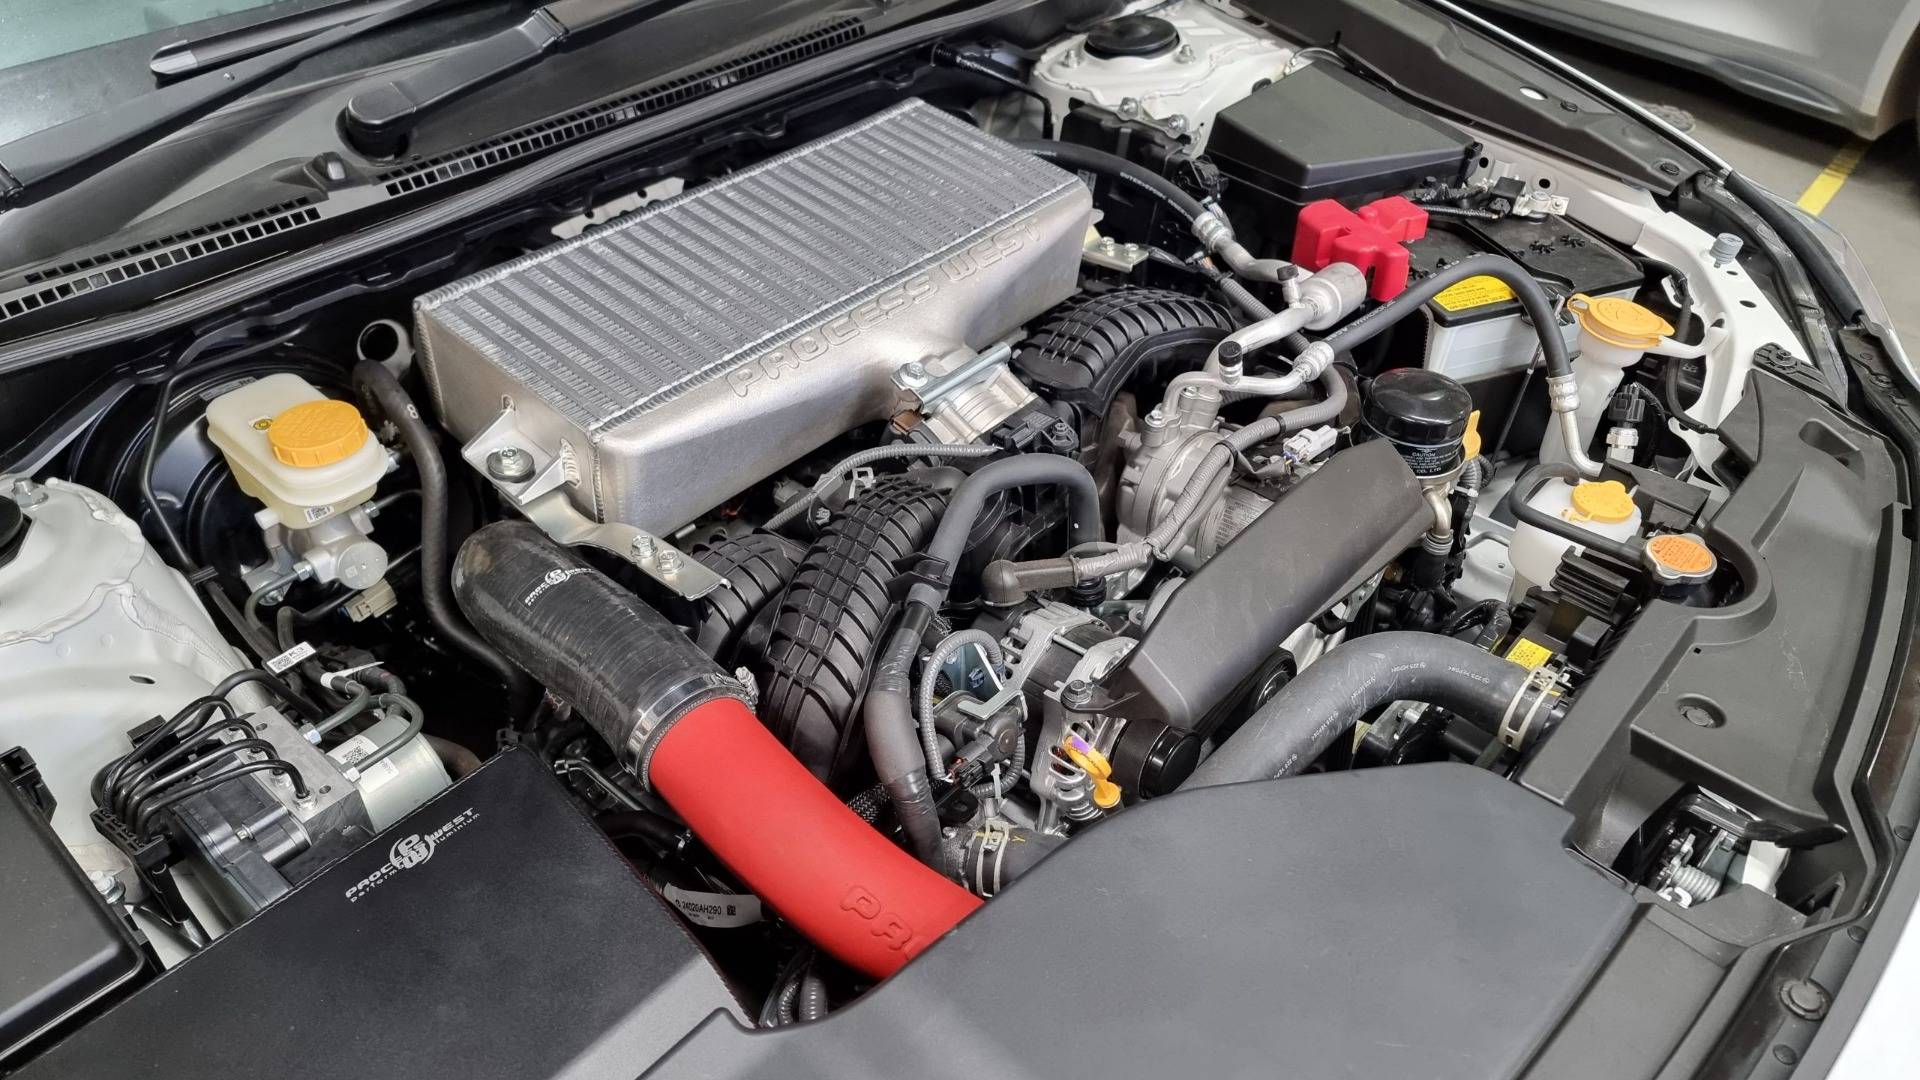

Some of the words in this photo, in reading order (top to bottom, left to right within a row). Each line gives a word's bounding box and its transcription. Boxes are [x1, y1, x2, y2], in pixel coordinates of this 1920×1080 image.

[726, 275, 938, 398] PROCESS
[939, 221, 1043, 283] WEST
[429, 807, 474, 841] WEST
[839, 884, 925, 961] PR
